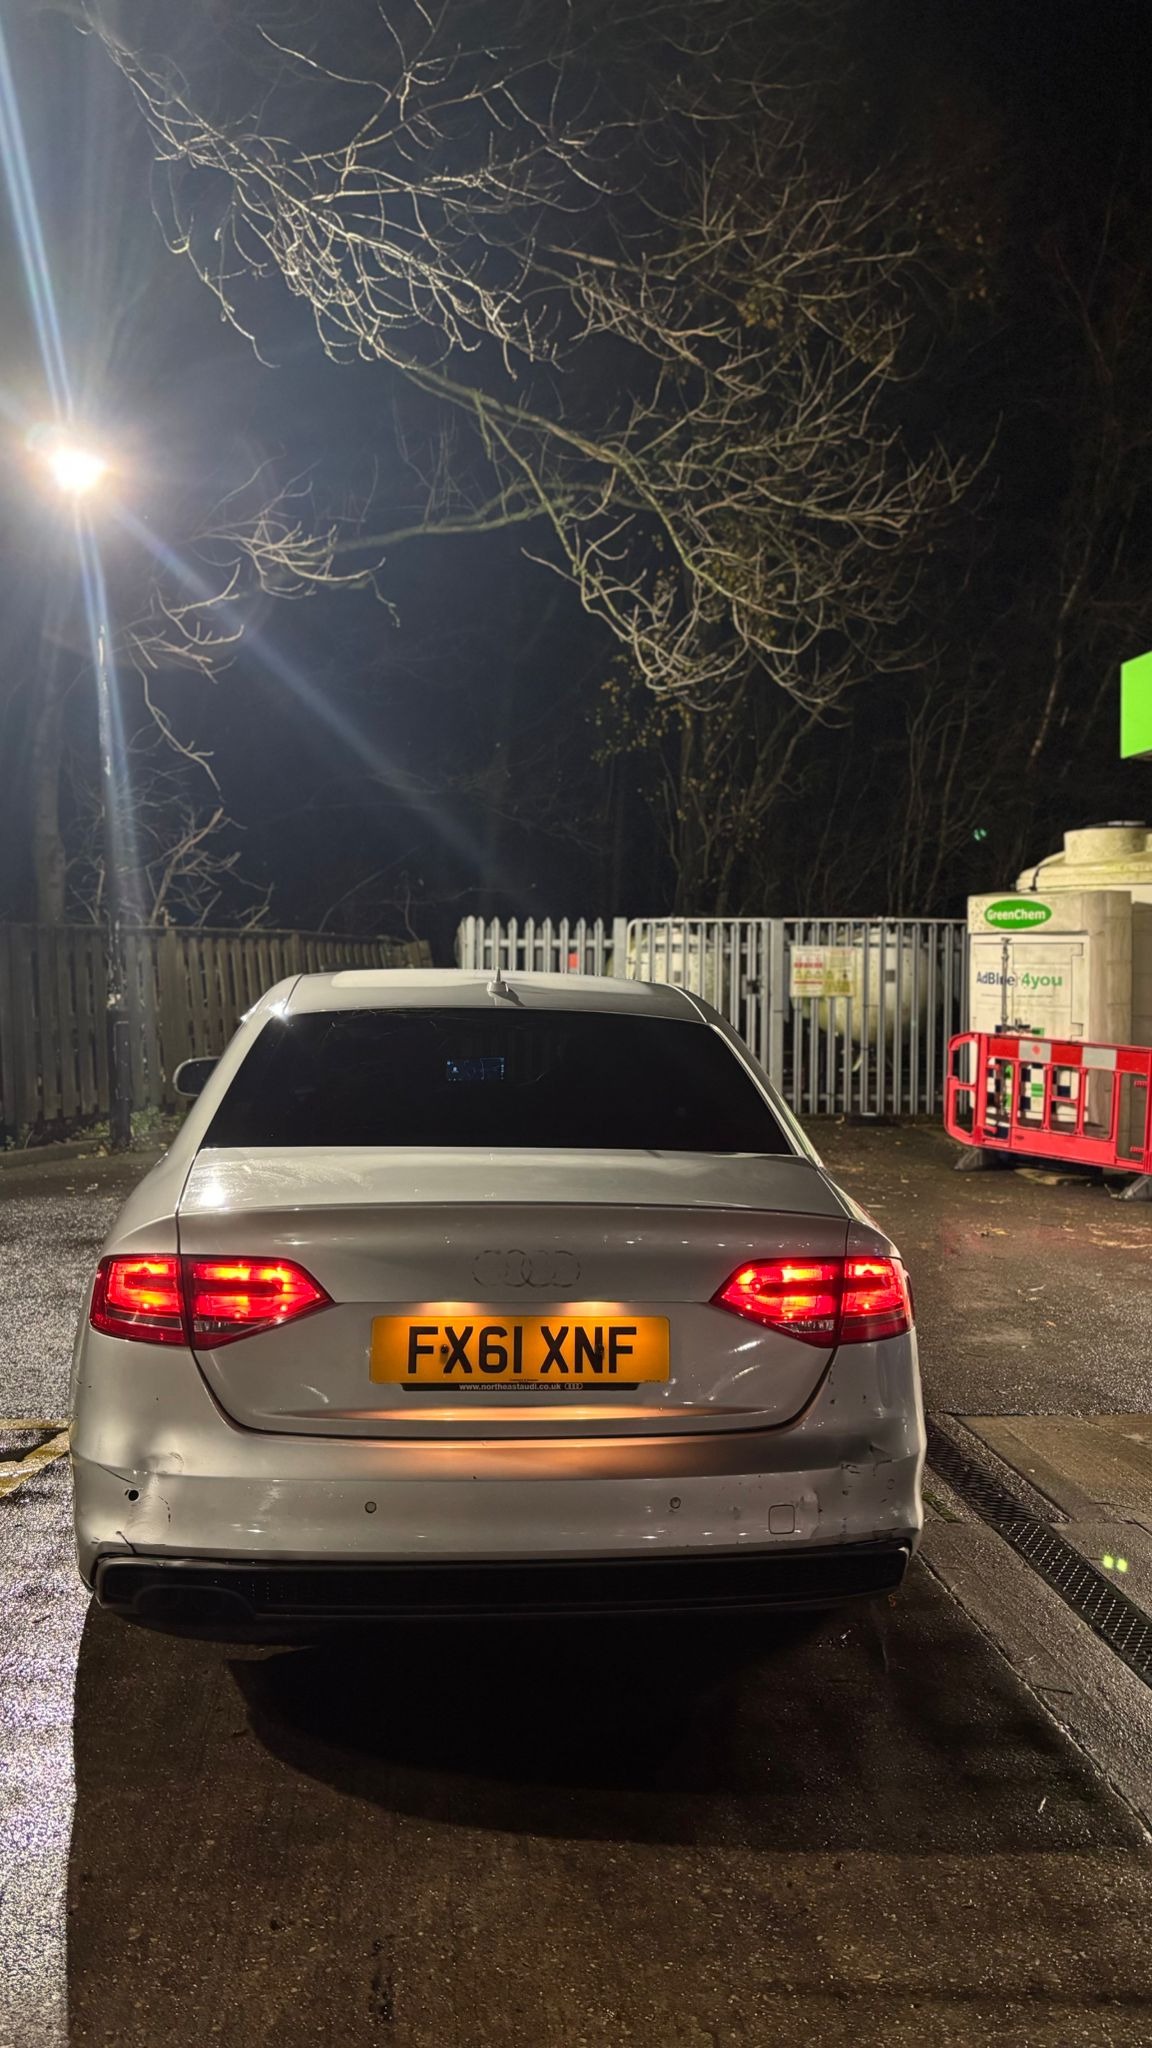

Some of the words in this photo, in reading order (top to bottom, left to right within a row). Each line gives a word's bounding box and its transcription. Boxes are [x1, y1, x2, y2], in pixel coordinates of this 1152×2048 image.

[987, 909, 1046, 921] GreenChem
[1021, 972, 1063, 989] 4you
[408, 1326, 522, 1374] FX61
[540, 1326, 637, 1374] XNF
[459, 1383, 561, 1391] www.northeastaudi.co.uk
